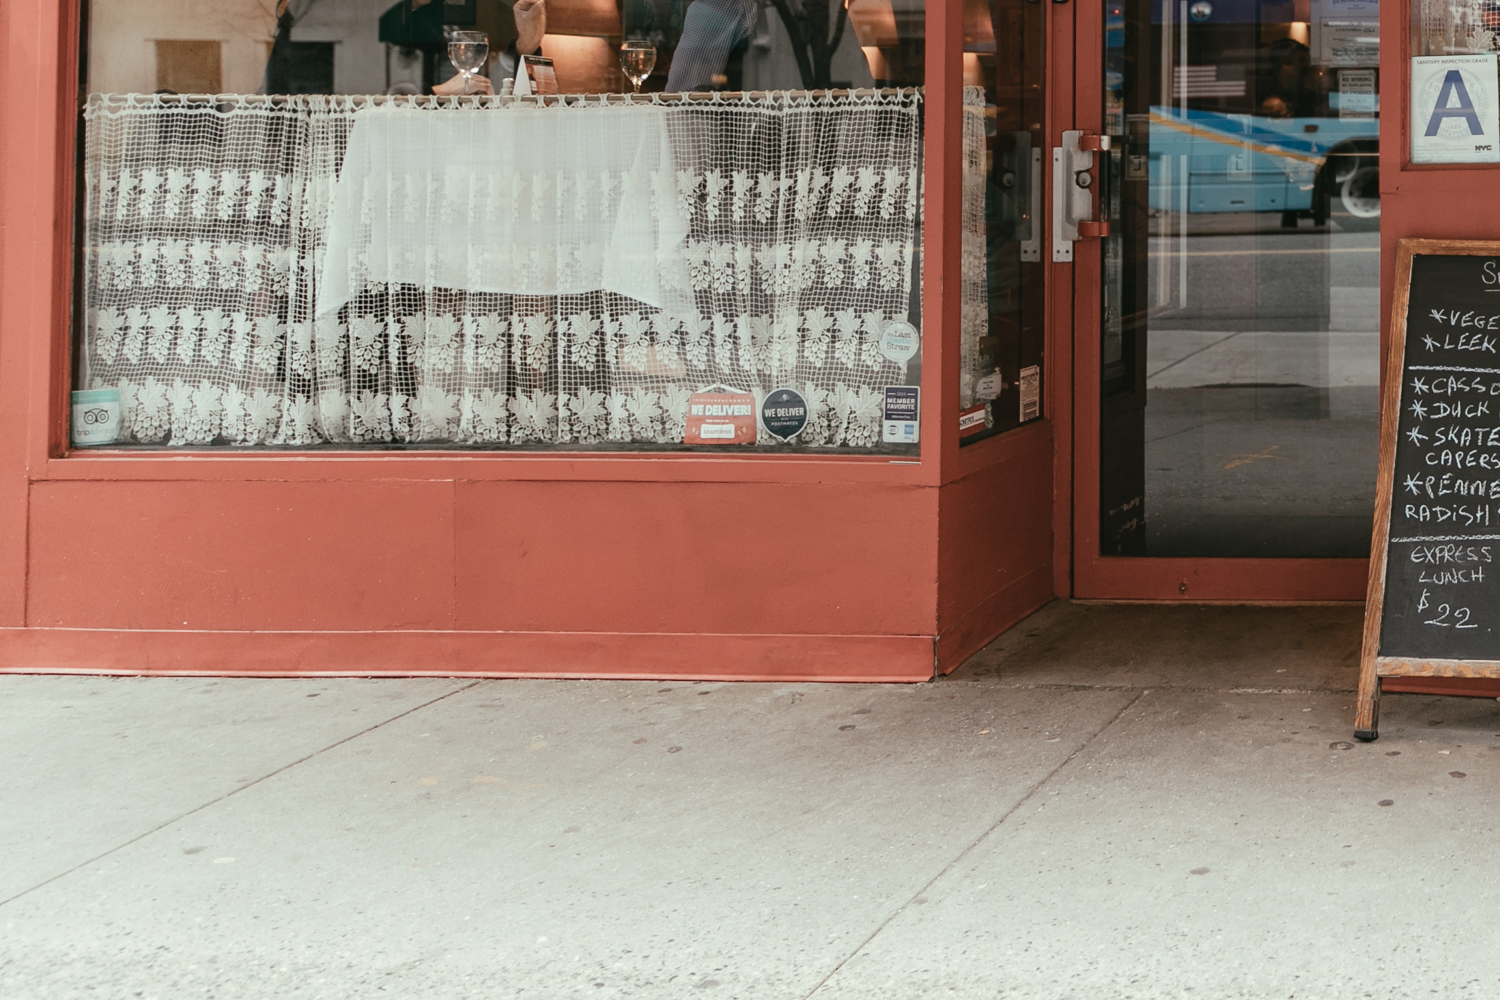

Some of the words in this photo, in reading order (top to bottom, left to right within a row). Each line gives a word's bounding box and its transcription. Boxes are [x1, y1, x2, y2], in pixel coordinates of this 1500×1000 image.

[1424, 69, 1485, 137] A
[1443, 332, 1497, 354] LEEK
[691, 404, 705, 416] WE
[763, 408, 776, 418] WE
[776, 407, 805, 417] DELIVER
[1430, 401, 1490, 419] DUCK
[1425, 450, 1500, 470] CAPERS
[1404, 504, 1490, 526] RADISH
[1410, 544, 1493, 565] EXPRESS
[1418, 566, 1486, 585] LUNCH
